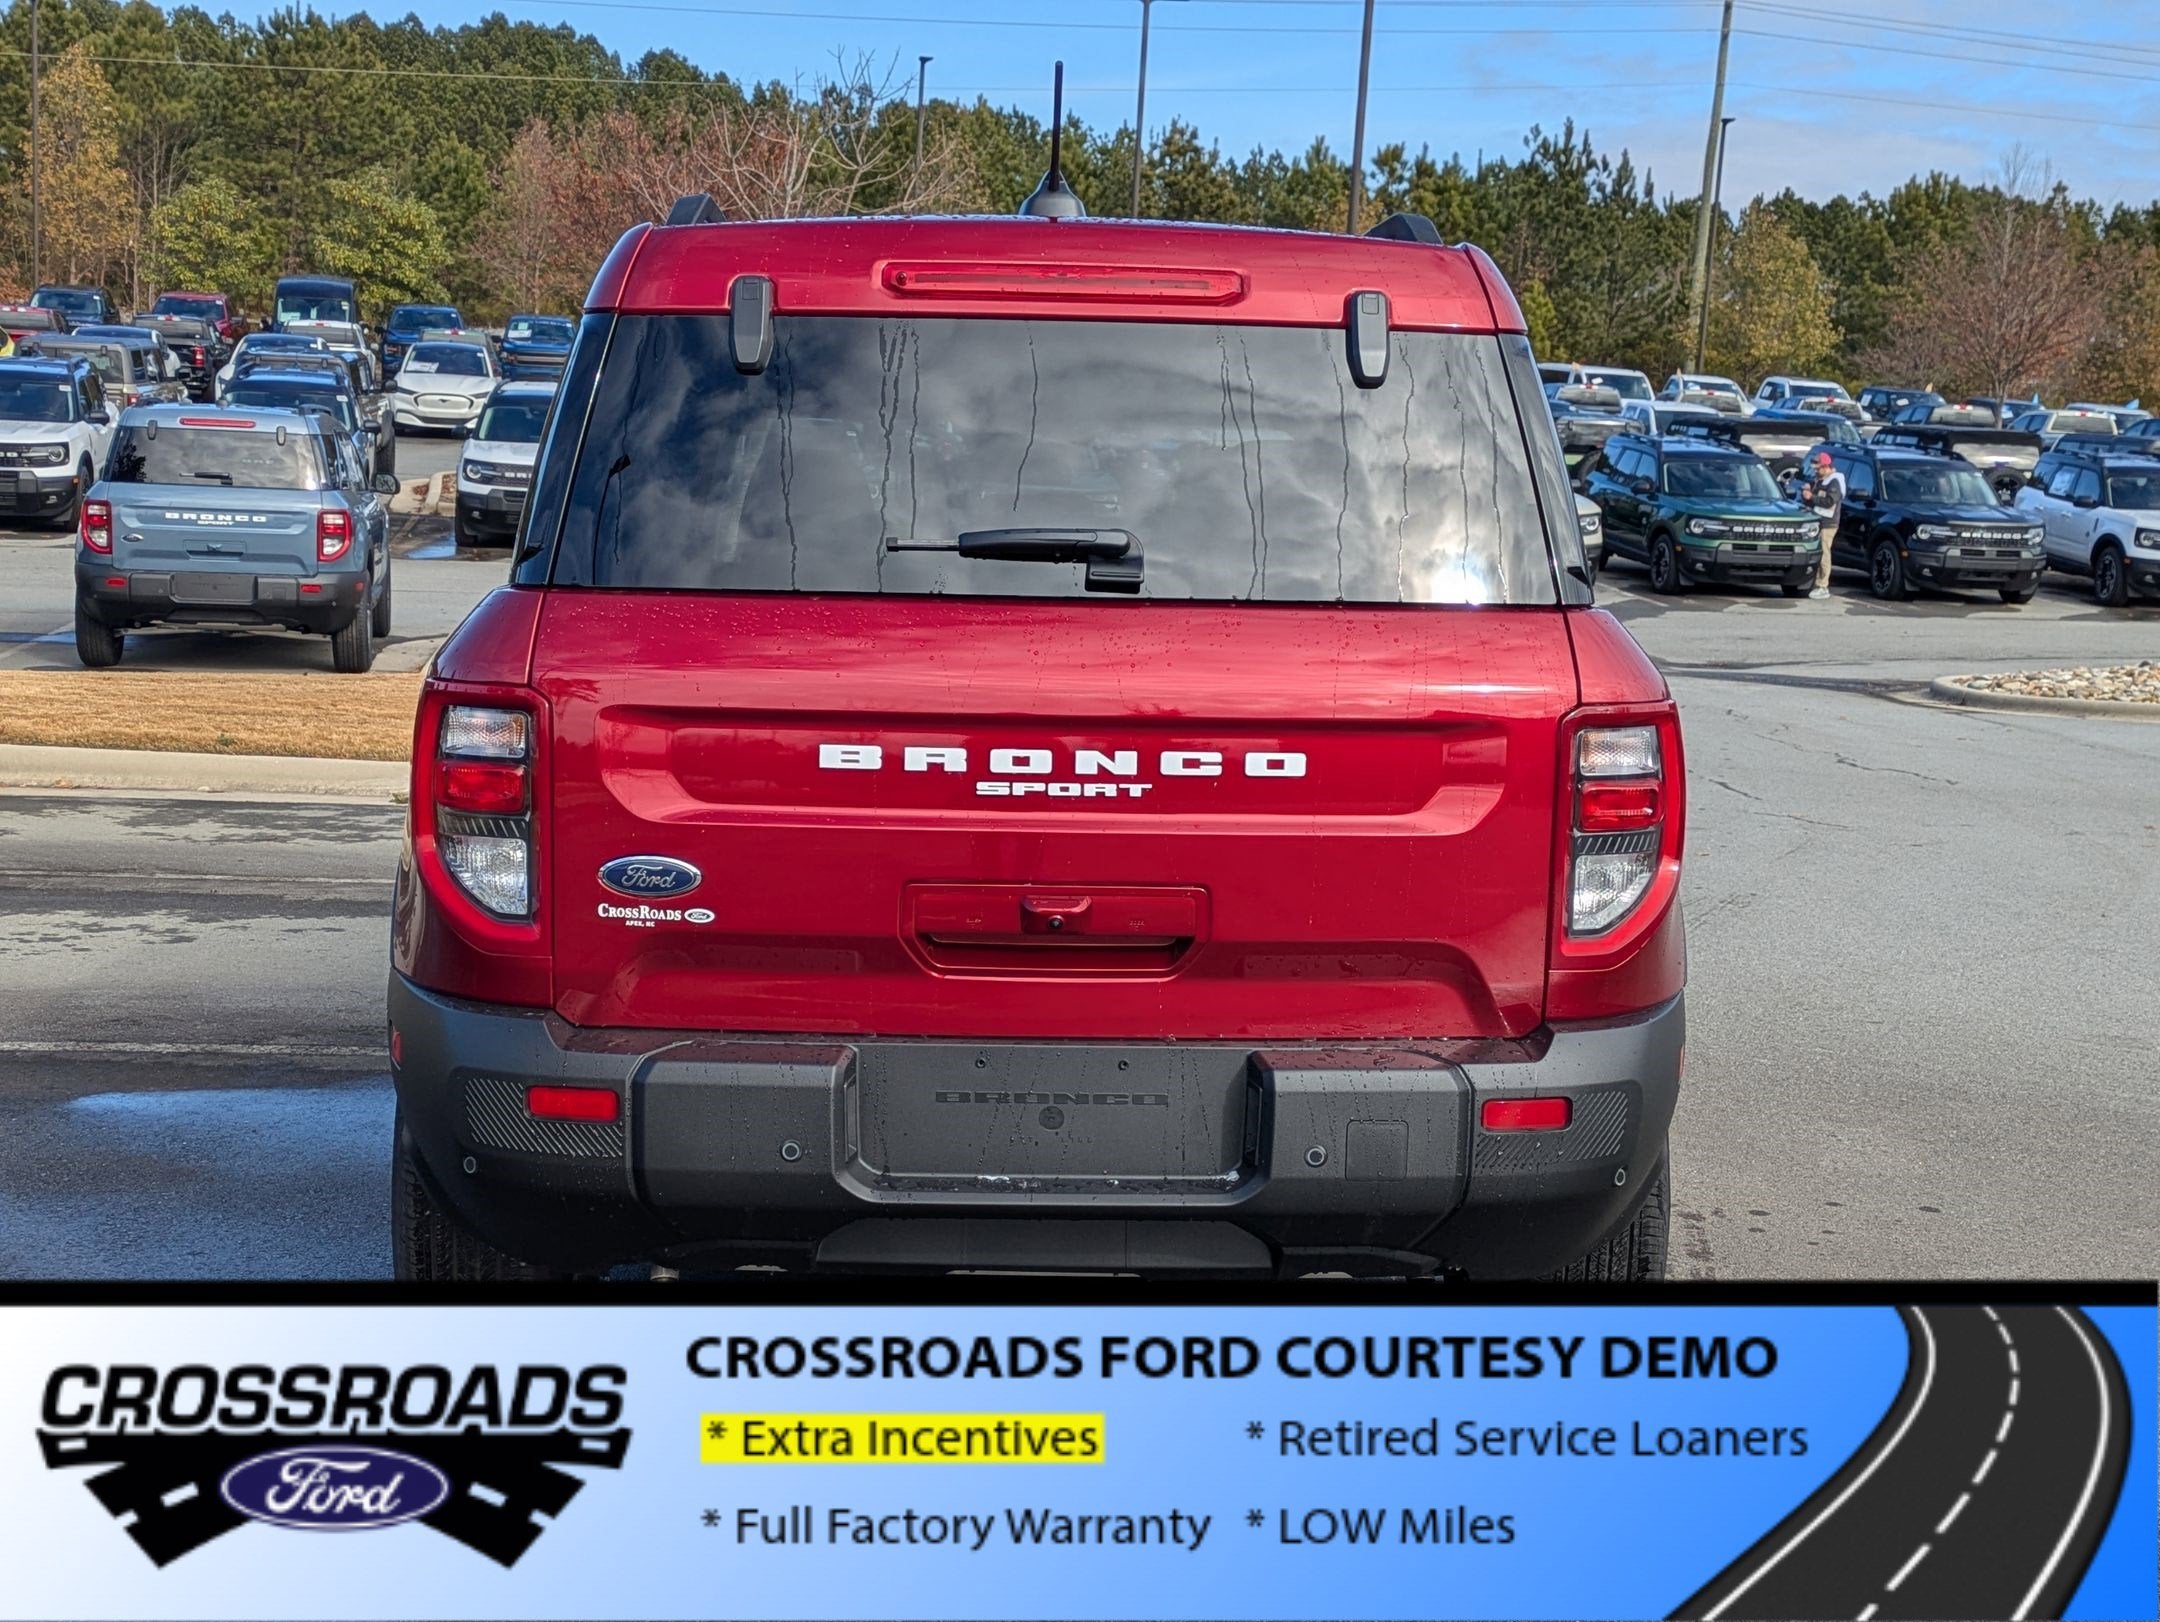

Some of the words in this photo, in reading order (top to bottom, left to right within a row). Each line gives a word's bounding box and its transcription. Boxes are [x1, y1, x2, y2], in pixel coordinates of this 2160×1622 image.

[819, 743, 1307, 777] BRONCO
[976, 781, 1153, 797] SPORT
[621, 864, 677, 888] Ford
[936, 1090, 1168, 1105] BRONCO
